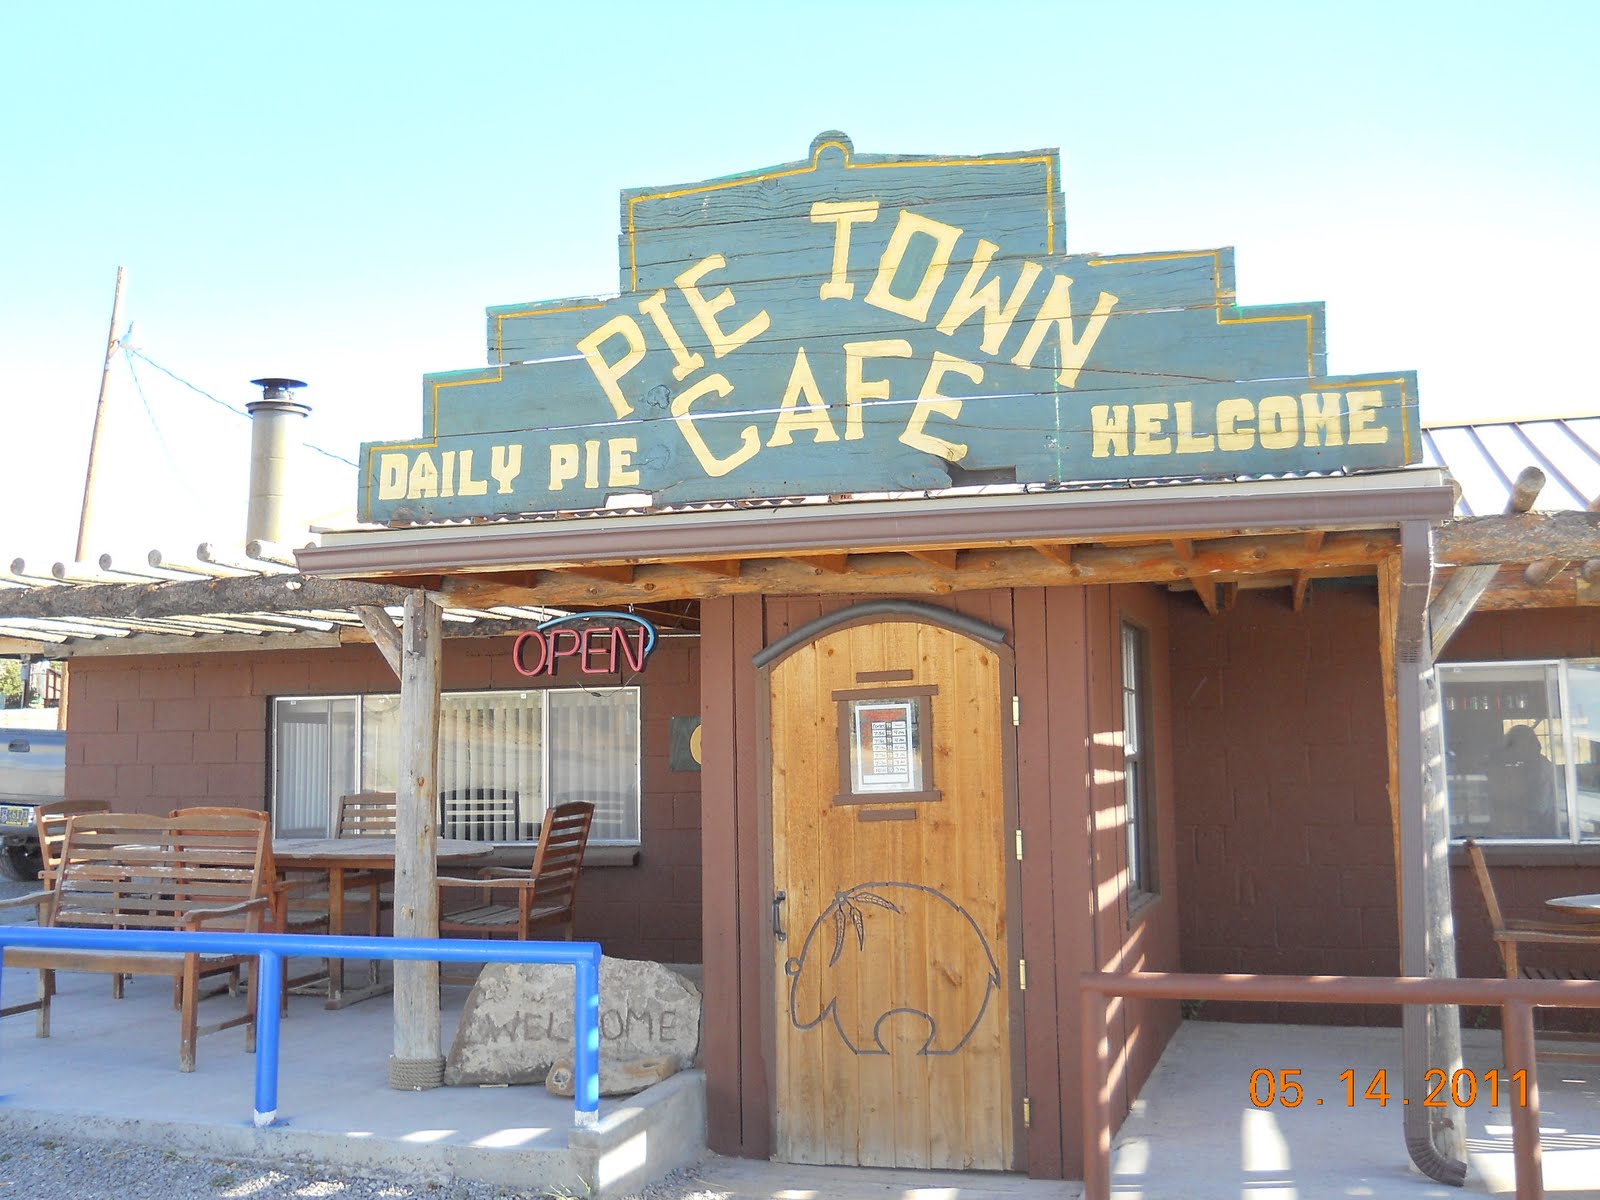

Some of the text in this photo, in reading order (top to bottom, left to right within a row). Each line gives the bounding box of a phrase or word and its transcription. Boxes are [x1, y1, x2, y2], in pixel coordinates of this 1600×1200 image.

[577, 200, 1118, 419] PIE TOWN
[671, 339, 985, 478] CAFE
[1091, 390, 1388, 458] WELCOME
[378, 438, 640, 500] DAILY PIE
[513, 626, 645, 677] OPEN
[485, 1008, 677, 1043] WELOME
